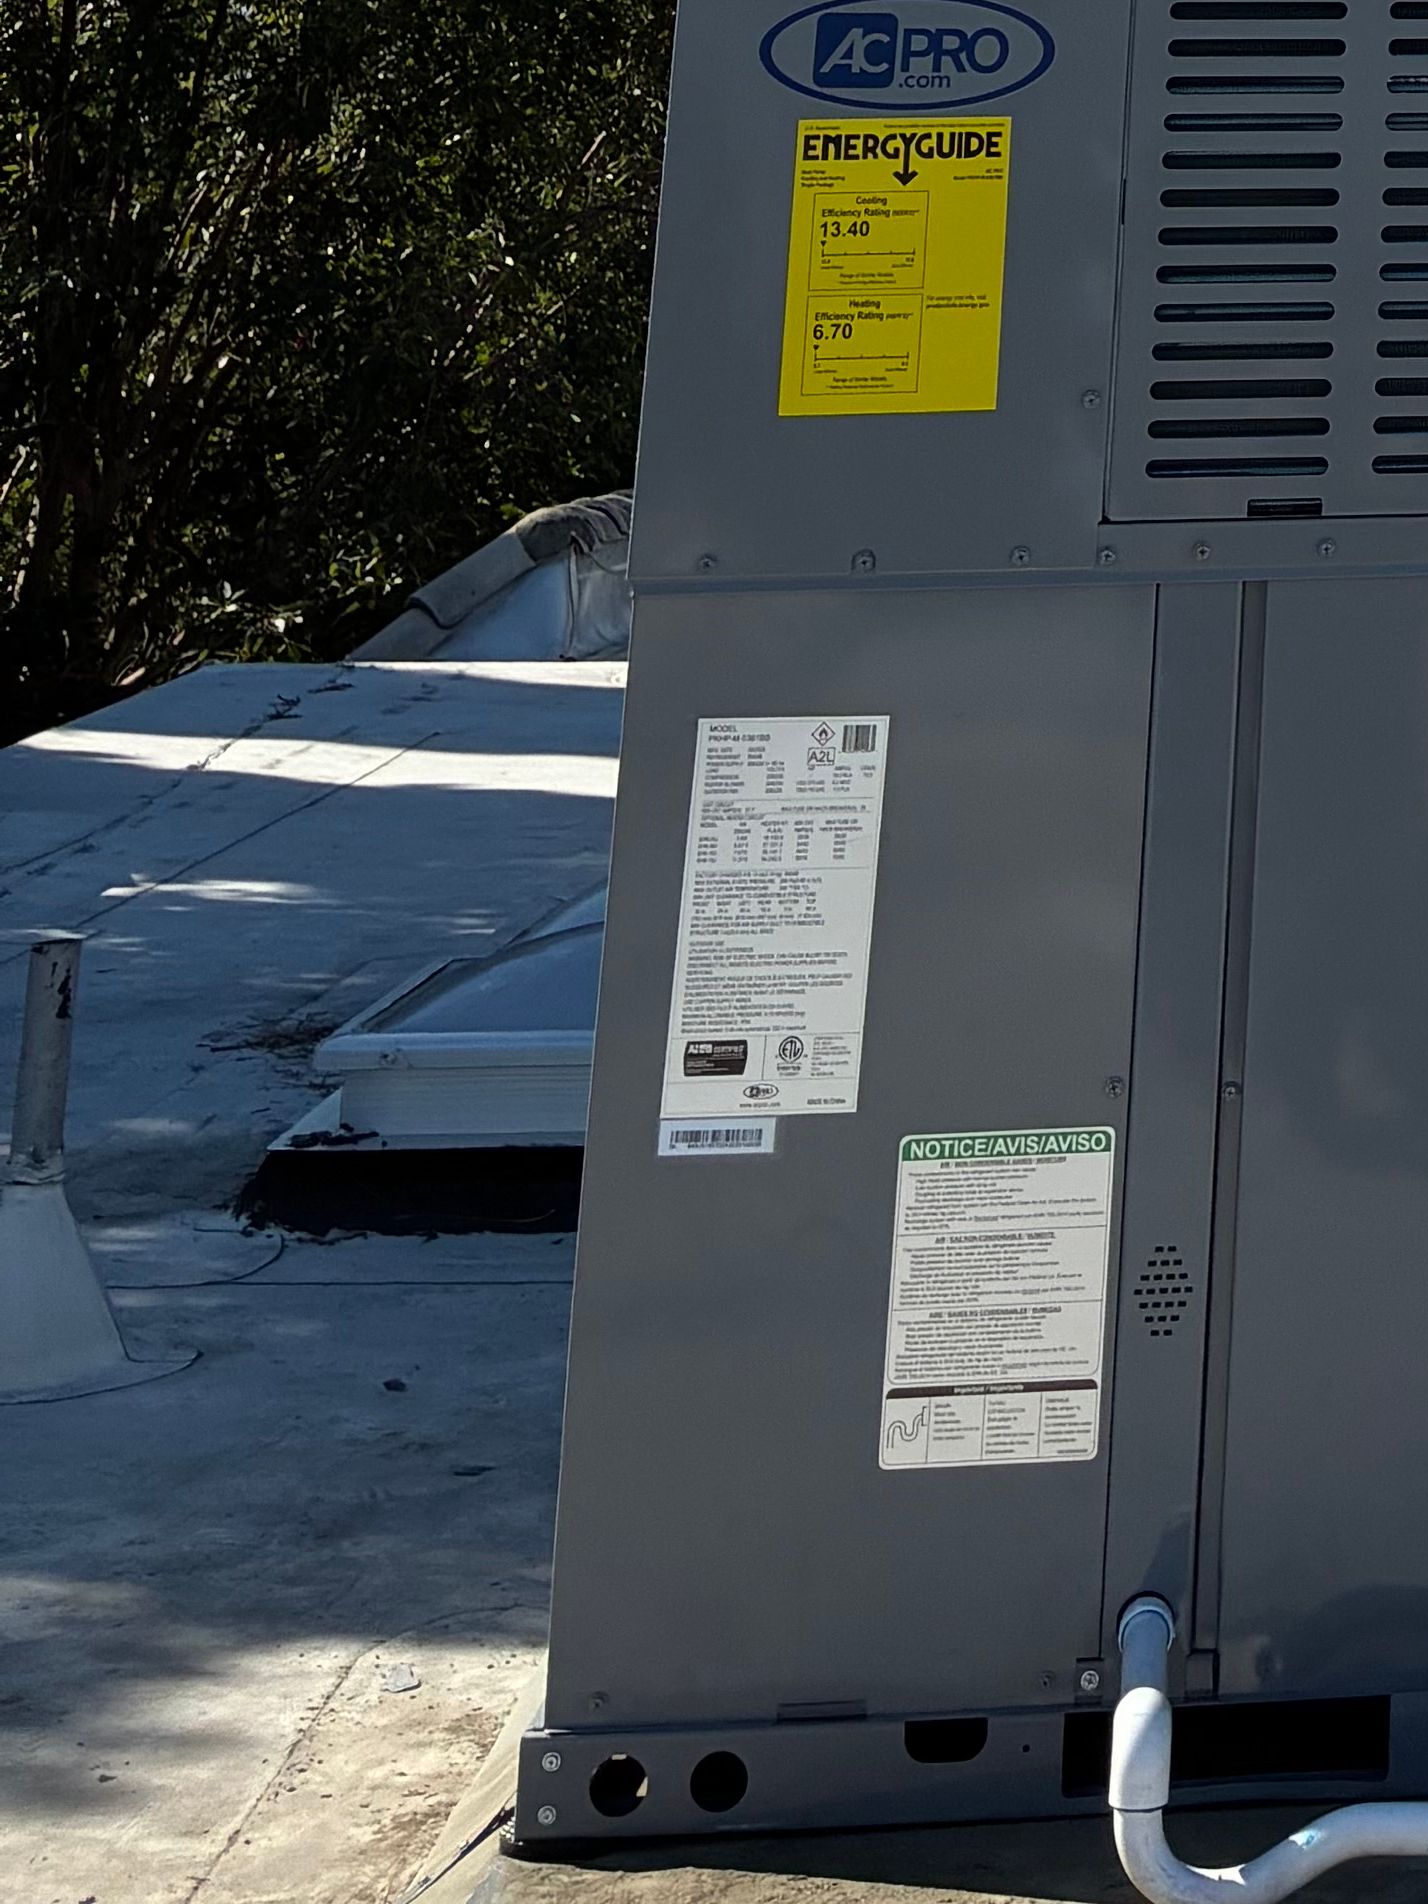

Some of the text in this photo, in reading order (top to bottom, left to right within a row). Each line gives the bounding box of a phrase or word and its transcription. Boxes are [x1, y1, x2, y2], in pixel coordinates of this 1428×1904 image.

[898, 72, 951, 89] .com
[802, 131, 1003, 162] ENERGYGUIDE
[855, 196, 888, 206] Cooling
[821, 208, 862, 218] Efficiency
[863, 207, 892, 218] Rating
[820, 220, 870, 238] 13.40
[848, 299, 881, 309] Heating
[814, 312, 855, 322] Efficiency
[857, 311, 885, 321] Rating
[812, 323, 854, 341] 6.70
[808, 750, 835, 763] A2L
[909, 1133, 1107, 1160] NOTICE/AVIS/AVISO
